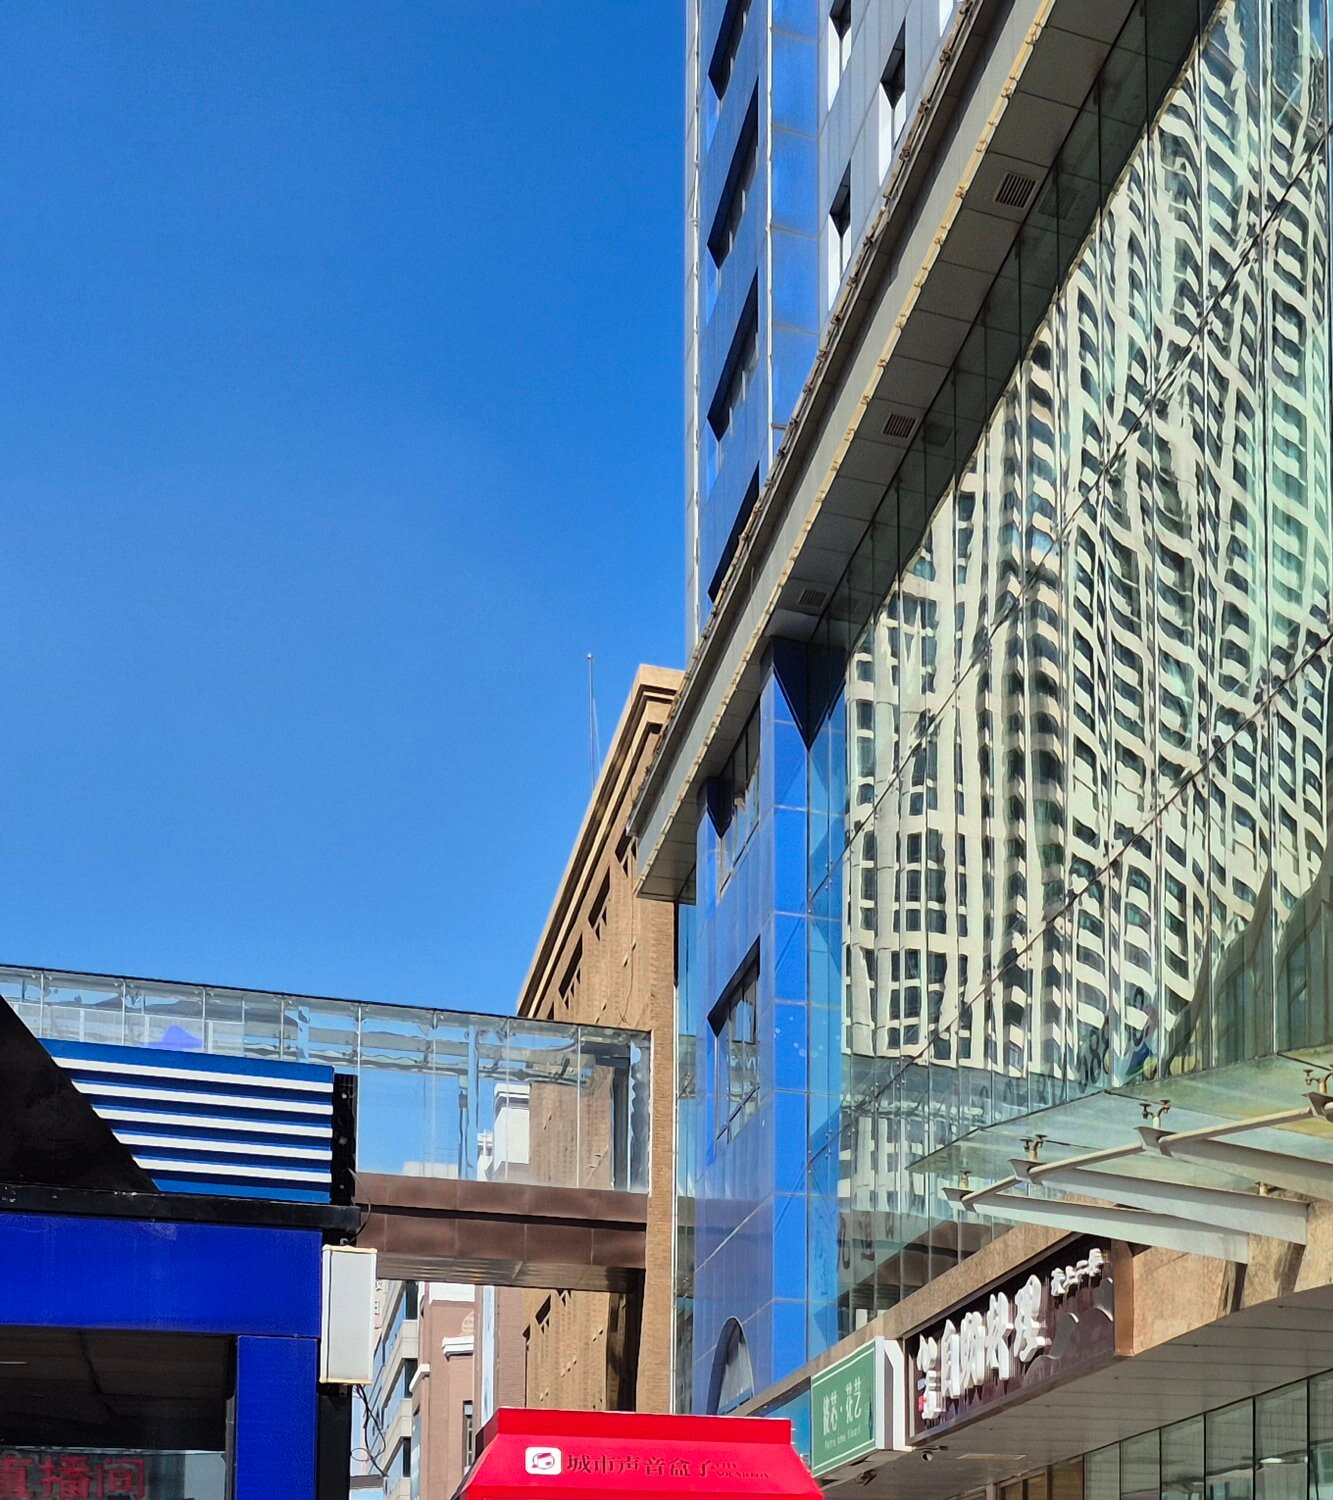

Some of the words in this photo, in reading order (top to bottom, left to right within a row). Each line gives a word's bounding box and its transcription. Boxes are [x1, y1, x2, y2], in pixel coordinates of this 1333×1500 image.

[0, 1453, 145, 1500] 直播间
[566, 1454, 714, 1478] 城市声音盒子
